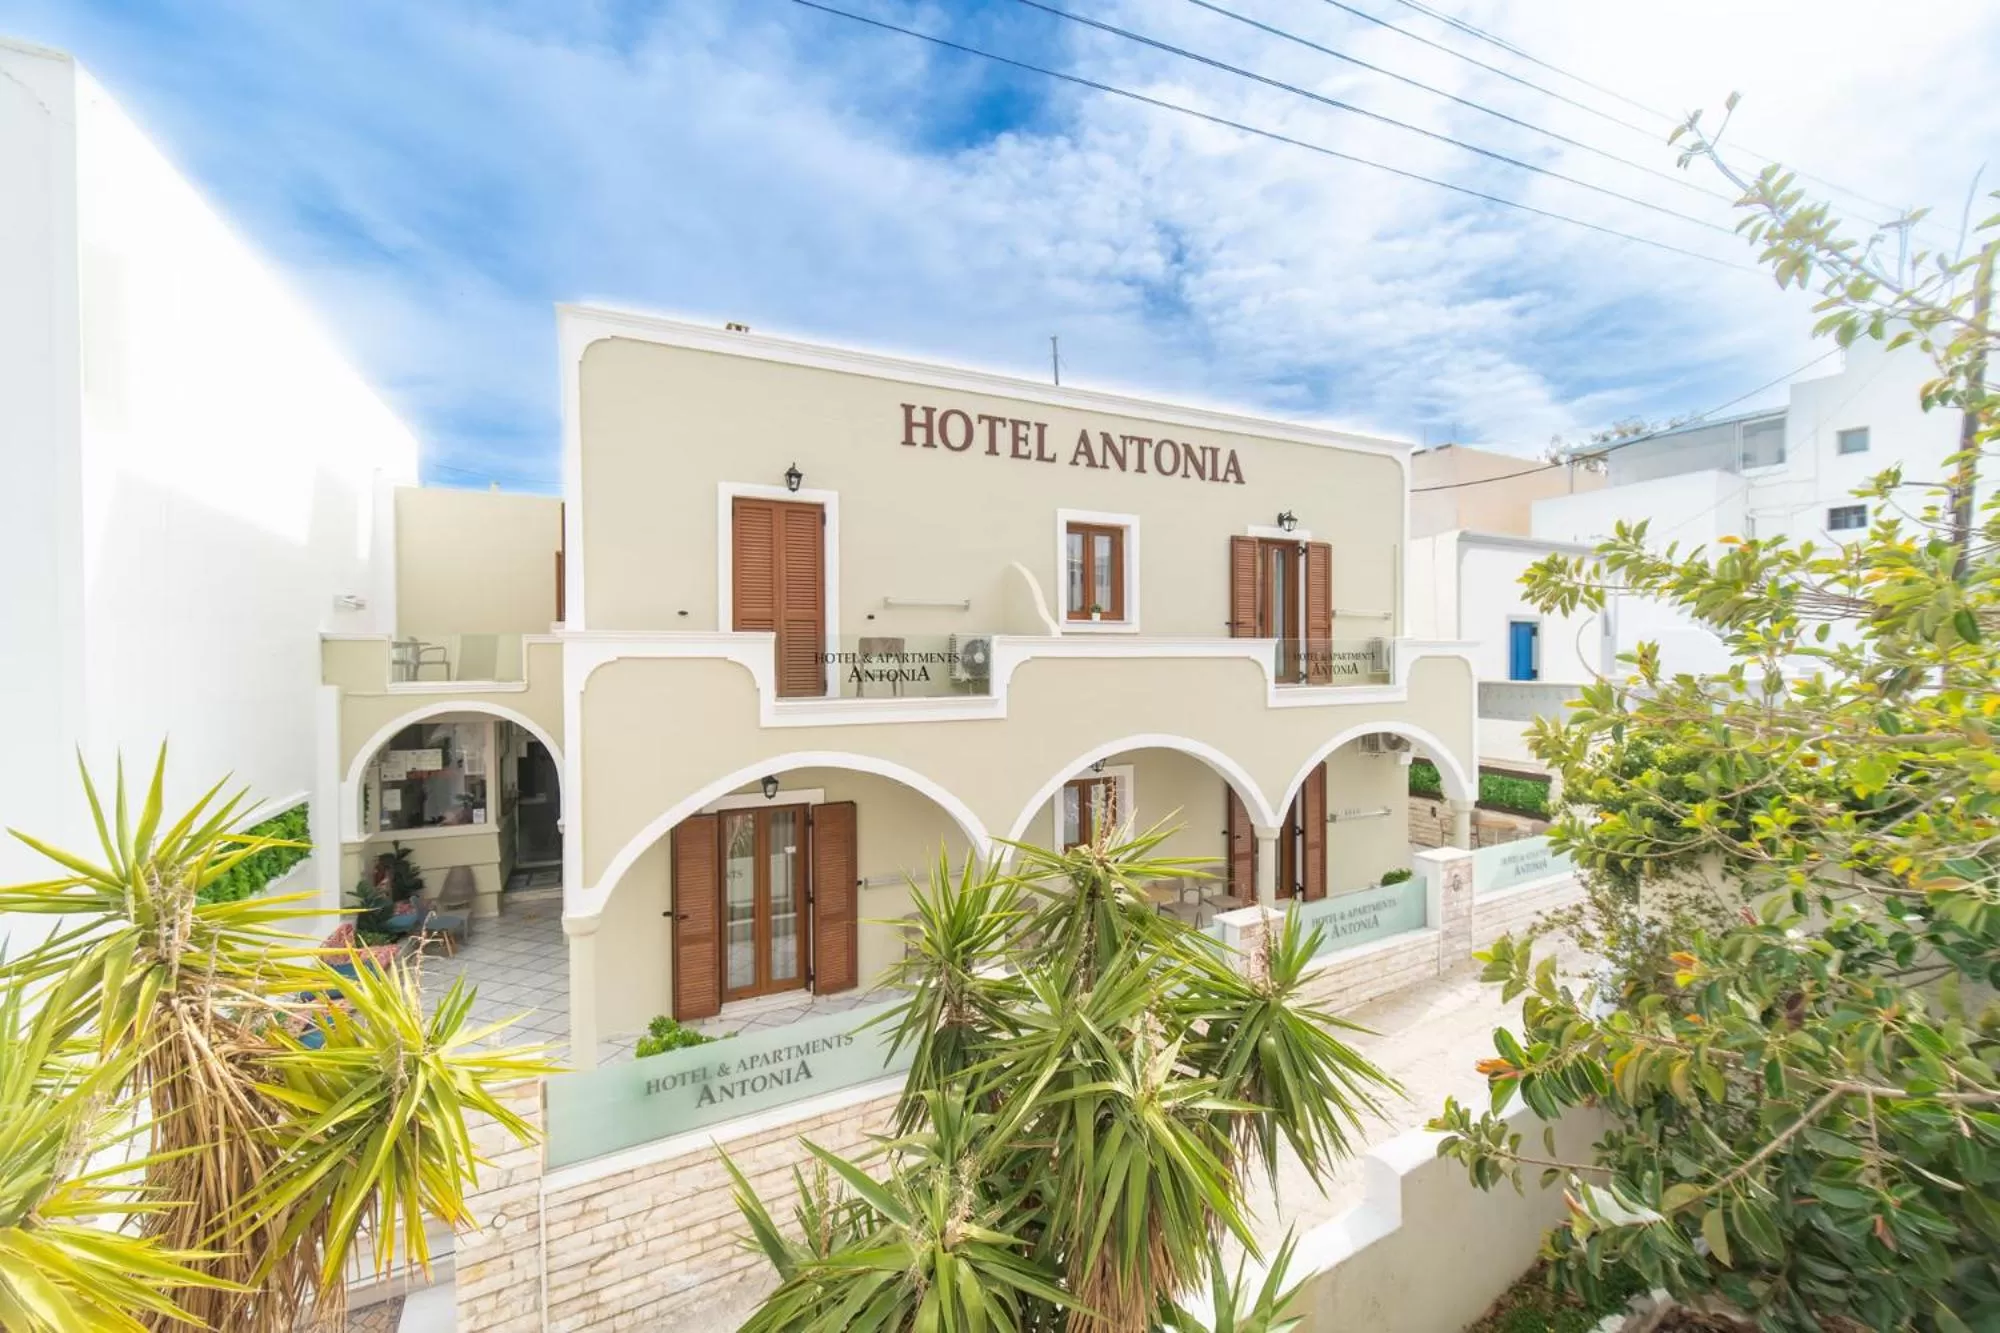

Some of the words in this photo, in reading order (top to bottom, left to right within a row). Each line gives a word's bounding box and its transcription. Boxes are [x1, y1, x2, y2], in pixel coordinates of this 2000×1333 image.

[900, 402, 1057, 464] HOTEL
[1069, 428, 1246, 485] ANTONIA
[814, 652, 857, 665] HOTEL
[863, 652, 873, 664] &
[876, 651, 960, 664] APARTMENTS
[848, 665, 931, 683] ANTONIA
[1331, 914, 1380, 940] ANTONIA
[644, 1067, 712, 1097] HOTEL
[716, 1062, 731, 1078] &
[735, 1033, 854, 1074] APARTMENTS
[695, 1059, 813, 1109] ANTONIA
